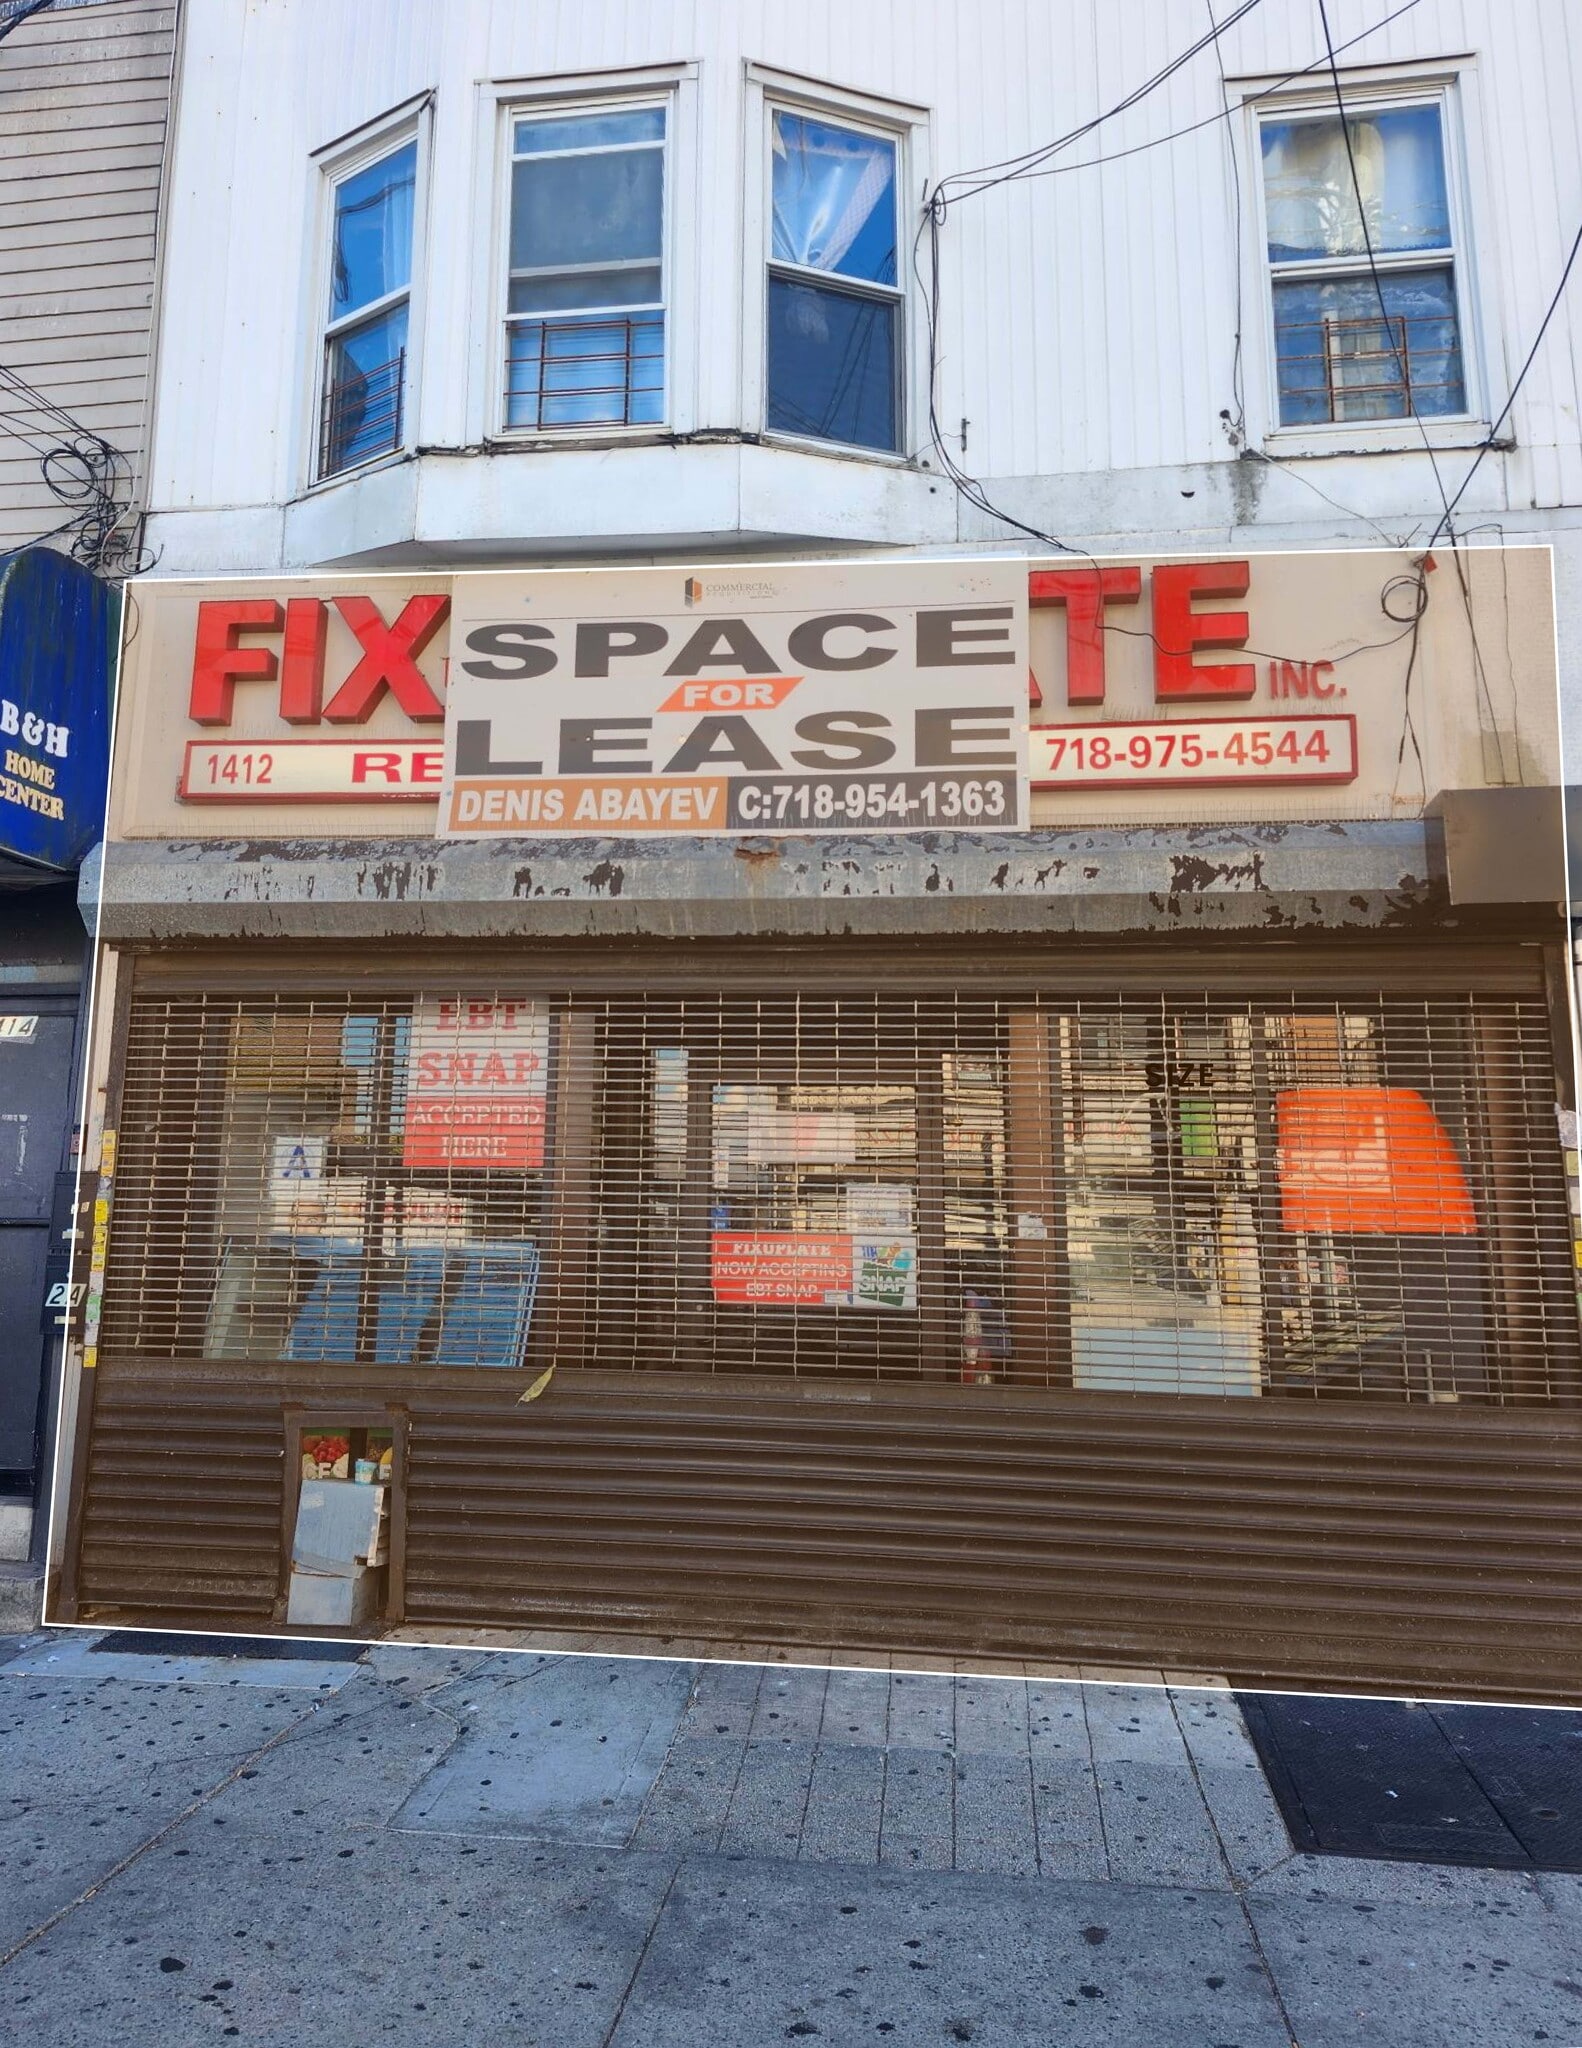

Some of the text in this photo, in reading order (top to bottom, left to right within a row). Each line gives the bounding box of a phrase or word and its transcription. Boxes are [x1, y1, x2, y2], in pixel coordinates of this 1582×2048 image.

[461, 606, 1016, 681] SPACE
[1029, 560, 1347, 707] TE INC.
[189, 594, 451, 726] FIX
[683, 683, 776, 708] FOR
[454, 705, 1017, 776] LEASE
[1046, 729, 1330, 771] 718-975-4544
[5, 749, 55, 790] HOME
[208, 753, 273, 785] 1412
[351, 752, 444, 783] RE
[457, 780, 1006, 822] DENIS ABAYEV C:718-954-1363
[437, 997, 527, 1031] EBT
[418, 1052, 540, 1087] SNAP
[411, 1105, 542, 1125] ACCEPTED
[282, 1145, 311, 1179] A
[440, 1136, 508, 1158] HERE
[717, 1261, 848, 1278] NOW ACCEPTING
[859, 1273, 906, 1293] SNAP
[746, 1284, 774, 1297] EBT
[776, 1284, 818, 1298] SNAP
